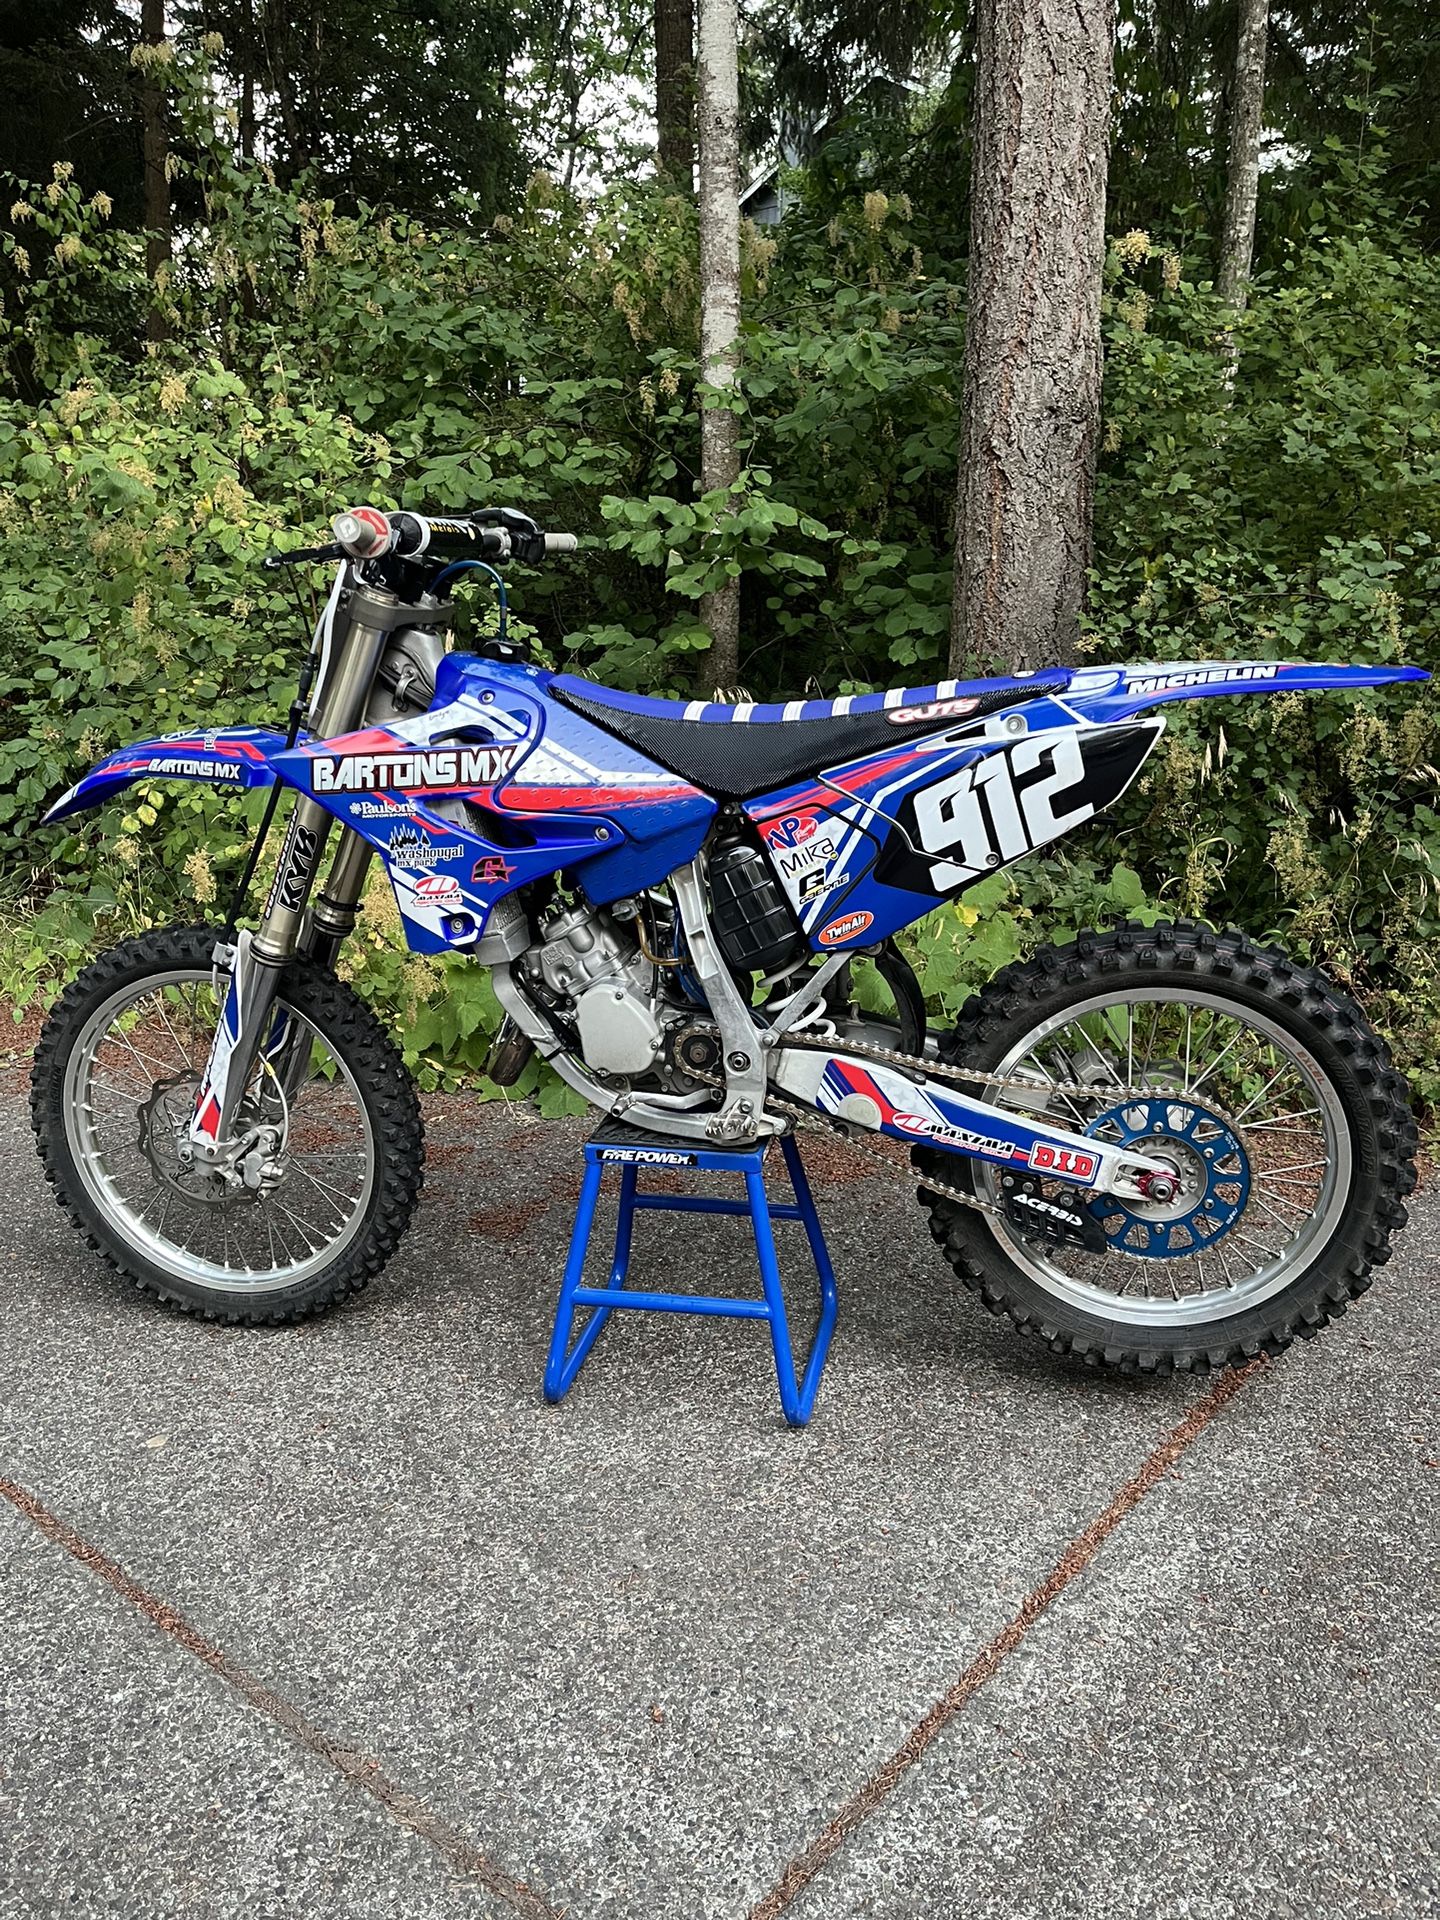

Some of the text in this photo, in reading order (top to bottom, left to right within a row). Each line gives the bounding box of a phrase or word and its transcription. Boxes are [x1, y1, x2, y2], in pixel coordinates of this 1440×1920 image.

[1128, 666, 1276, 695] MICHELIN
[888, 699, 979, 723] GUTS
[148, 759, 241, 780] BARTONS MX
[313, 749, 513, 791] BARTONS MX
[361, 799, 417, 814] Paulson's
[913, 730, 1094, 892] 912
[769, 817, 800, 848] VP
[396, 845, 463, 860] washougal
[414, 858, 436, 868] park
[277, 825, 318, 913] KYB
[1012, 1193, 1083, 1226] ACERBIS
